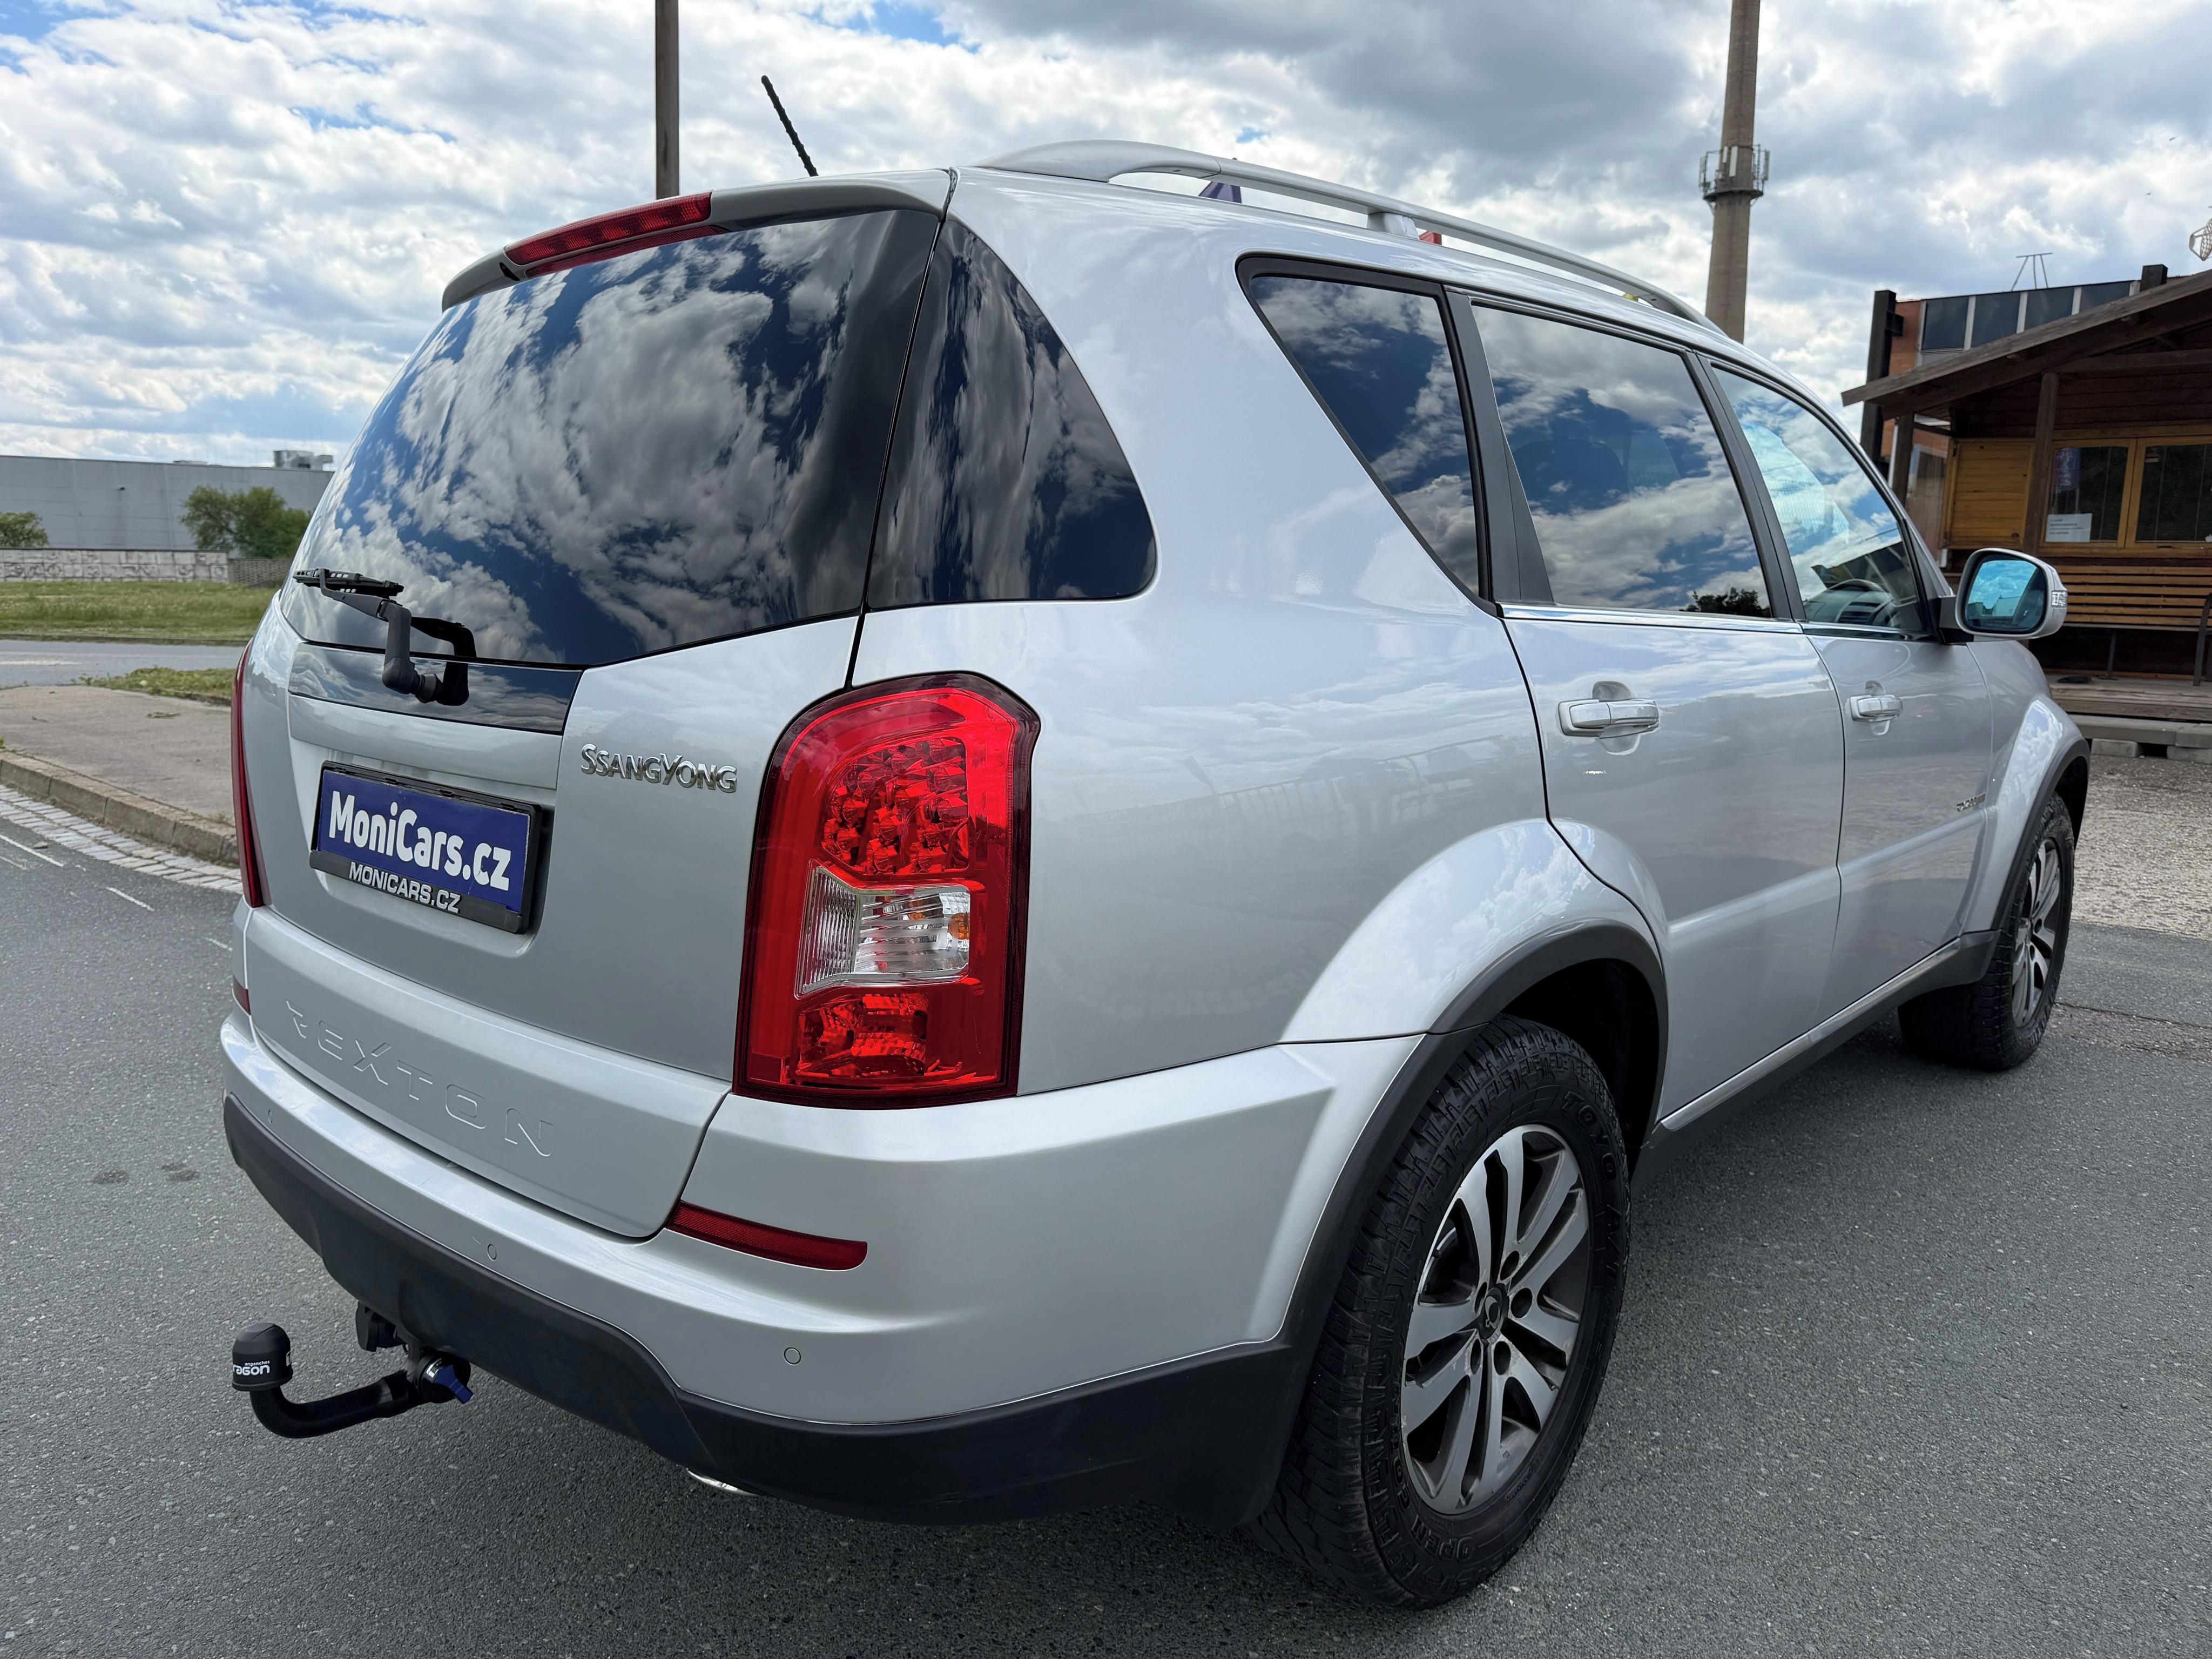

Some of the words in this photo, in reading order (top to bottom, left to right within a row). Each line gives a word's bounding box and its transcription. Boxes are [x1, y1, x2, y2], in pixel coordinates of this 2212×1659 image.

[329, 791, 511, 891] MoniCars.cz
[349, 861, 461, 914] MONICARS.CZ
[286, 1000, 554, 1157] REXTON
